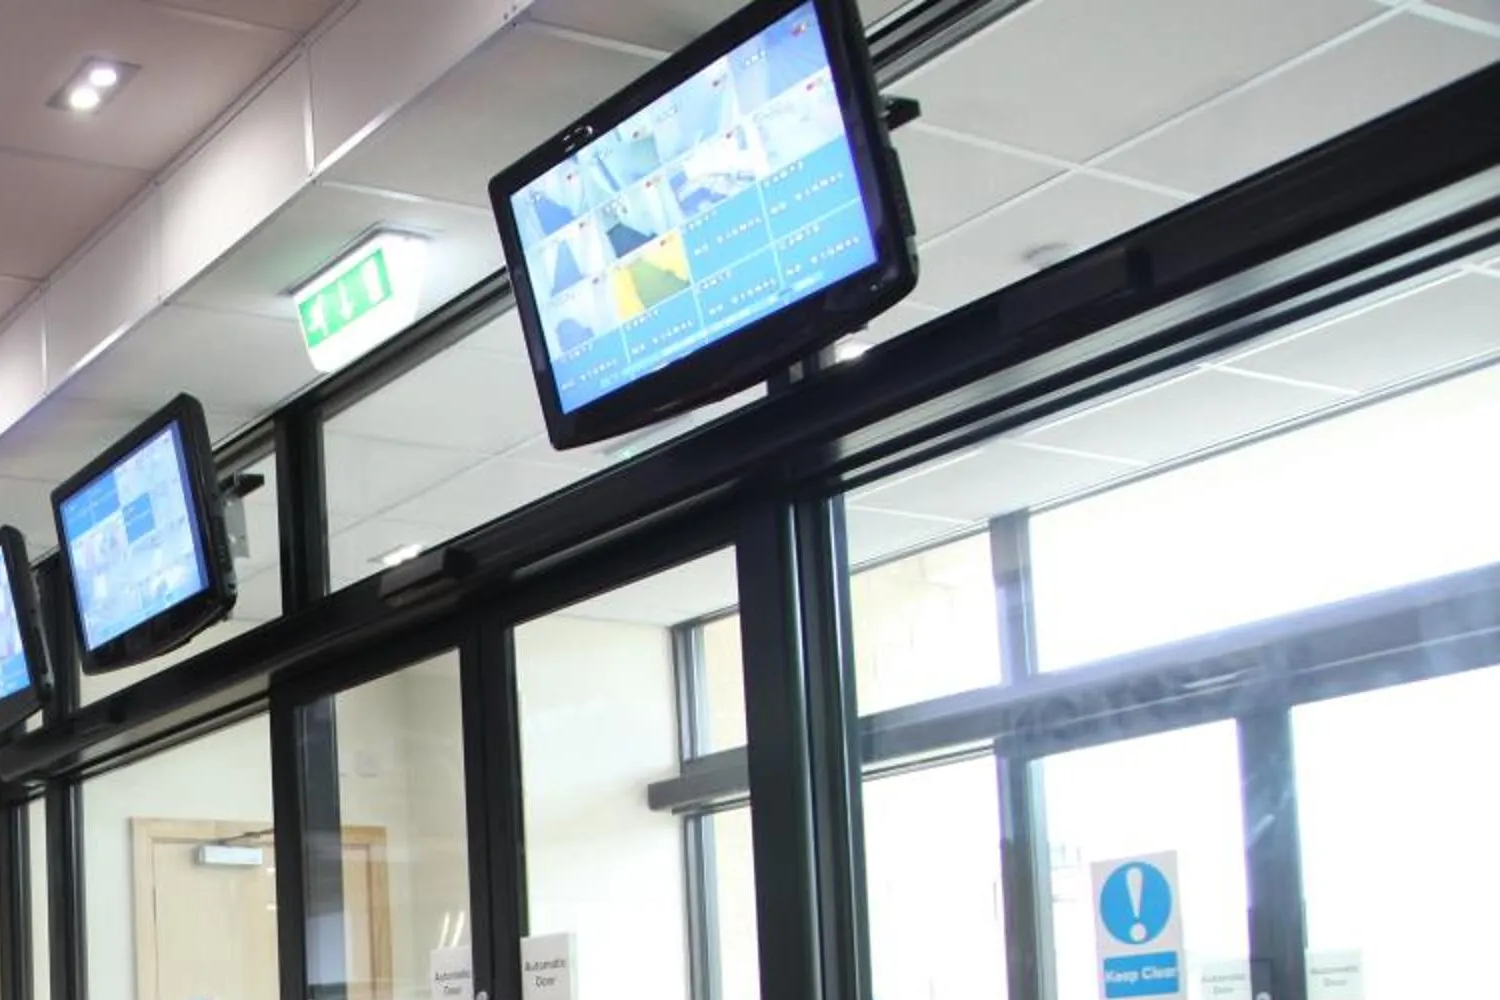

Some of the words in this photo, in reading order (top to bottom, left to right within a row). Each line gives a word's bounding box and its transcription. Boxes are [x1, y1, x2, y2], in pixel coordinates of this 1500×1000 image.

[524, 958, 566, 971] Automatic
[1105, 968, 1139, 984] Keep
[1141, 964, 1177, 980] Clear
